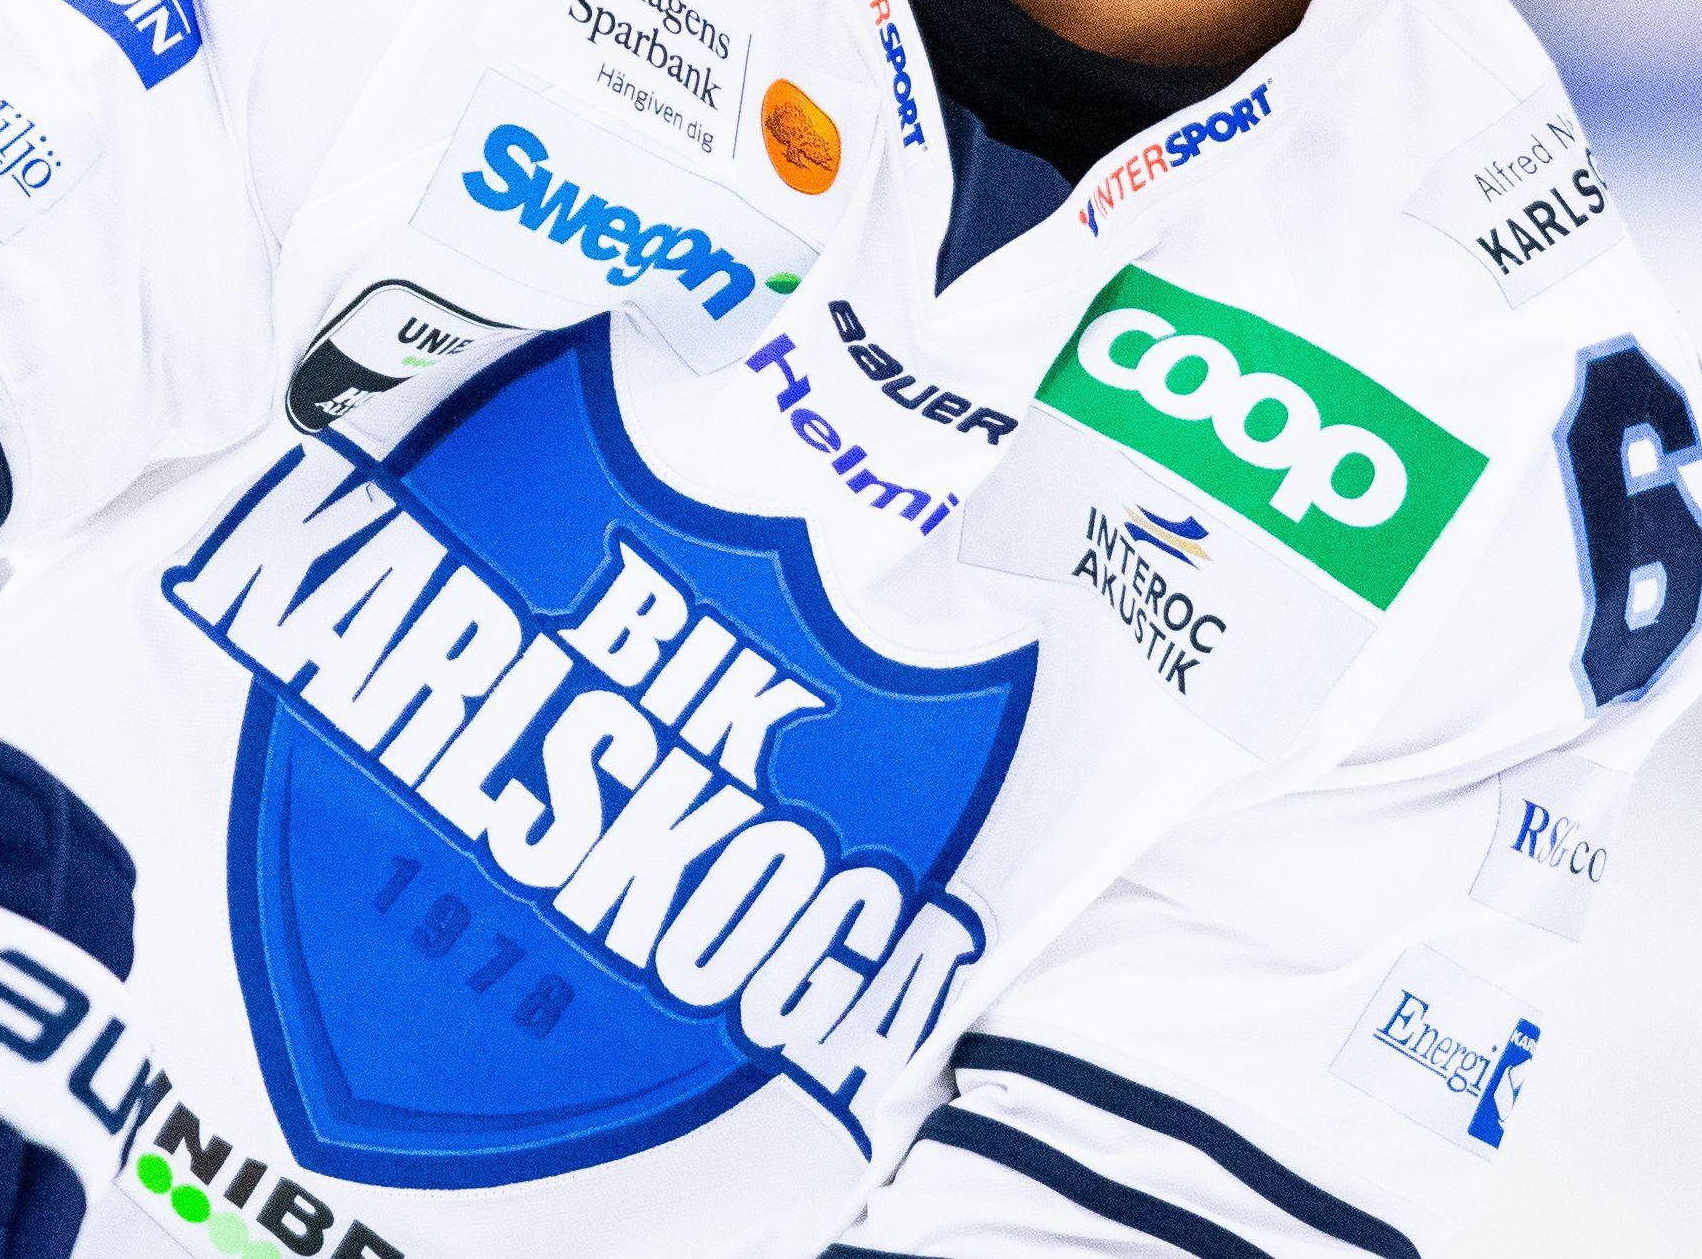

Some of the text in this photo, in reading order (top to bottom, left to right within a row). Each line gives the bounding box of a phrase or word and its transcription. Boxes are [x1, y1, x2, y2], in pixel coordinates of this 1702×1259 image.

[596, 61, 714, 154] Hängiven dig
[1093, 82, 1272, 220] INTERSPORT
[1473, 134, 1553, 204] Alfred
[462, 123, 756, 322] Swegon
[1476, 146, 1607, 276] KARLS
[745, 332, 959, 537] Helmi
[1076, 308, 1409, 529] coop
[1070, 547, 1201, 696] AKUSTIK
[1085, 505, 1228, 655] INTEROC
[570, 540, 829, 789] BIK
[174, 441, 977, 1112] KARLSKOGA
[371, 855, 577, 1041] 1978
[1376, 989, 1498, 1093] Energi
